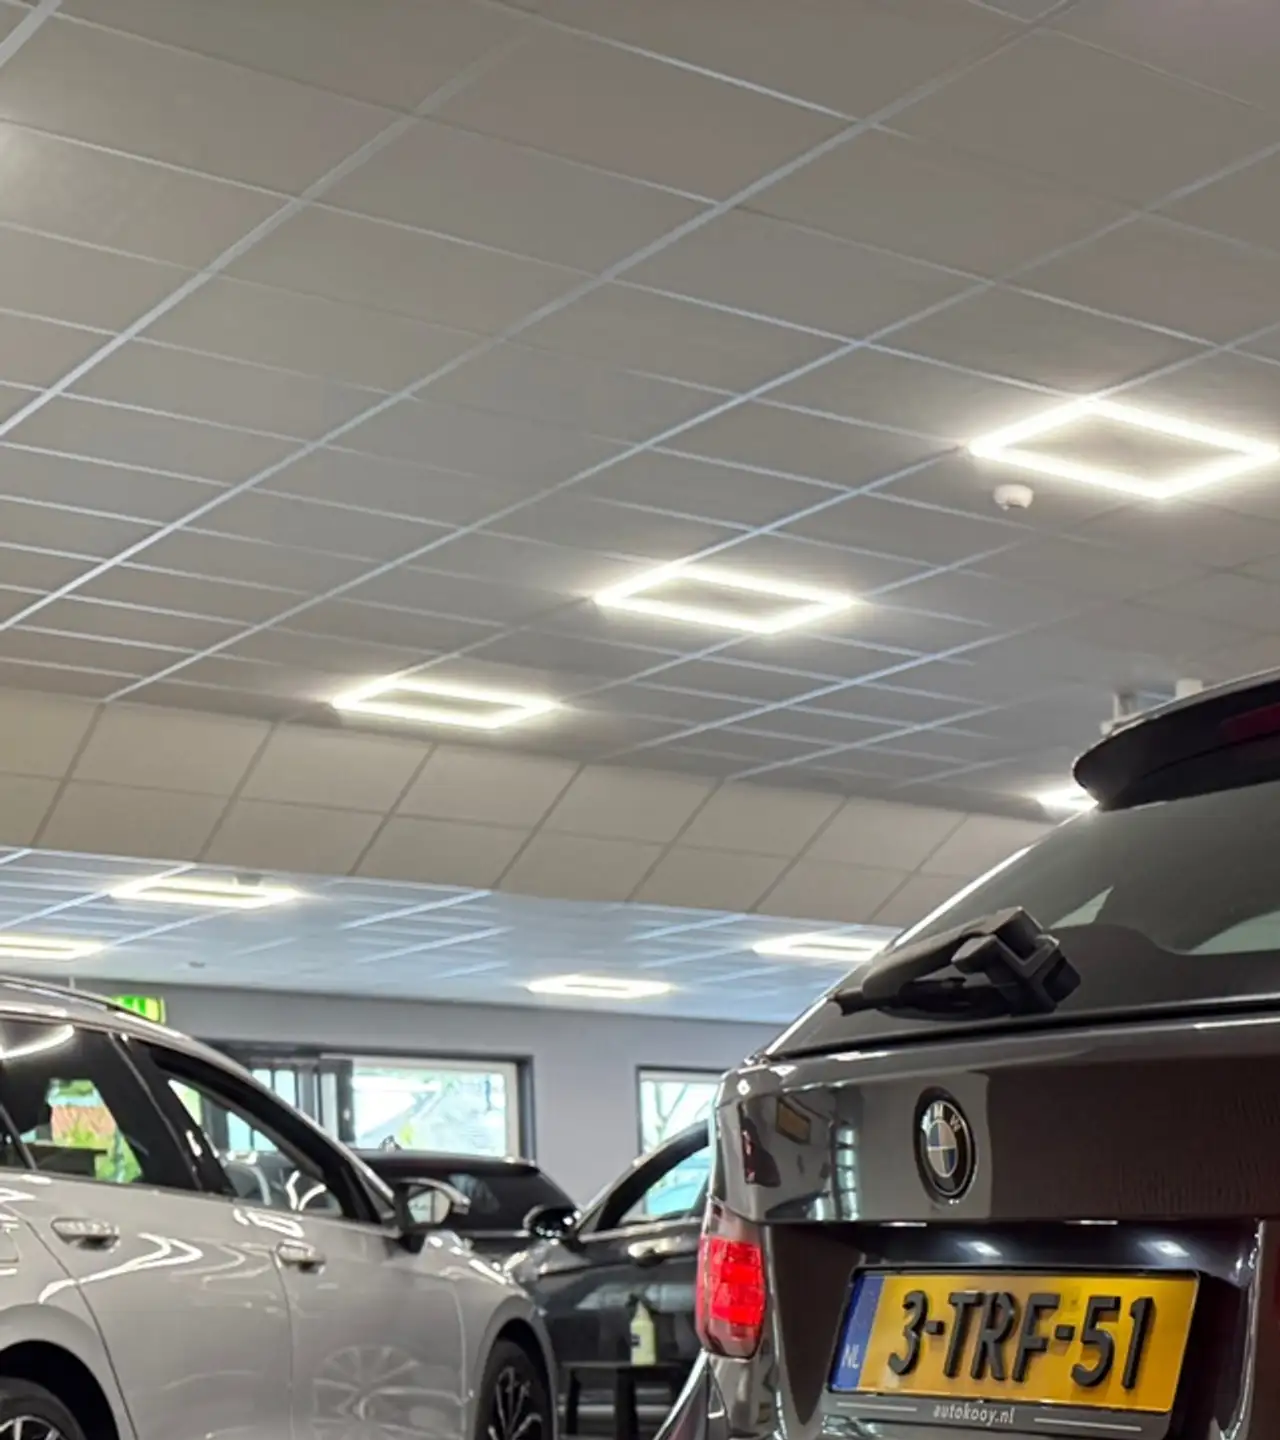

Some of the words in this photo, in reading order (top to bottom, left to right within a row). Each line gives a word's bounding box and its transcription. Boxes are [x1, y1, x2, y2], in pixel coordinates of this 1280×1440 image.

[888, 1290, 1155, 1390] 3-TRF-51
[842, 1343, 860, 1370] NL
[933, 1403, 1015, 1427] autokooy.nl
